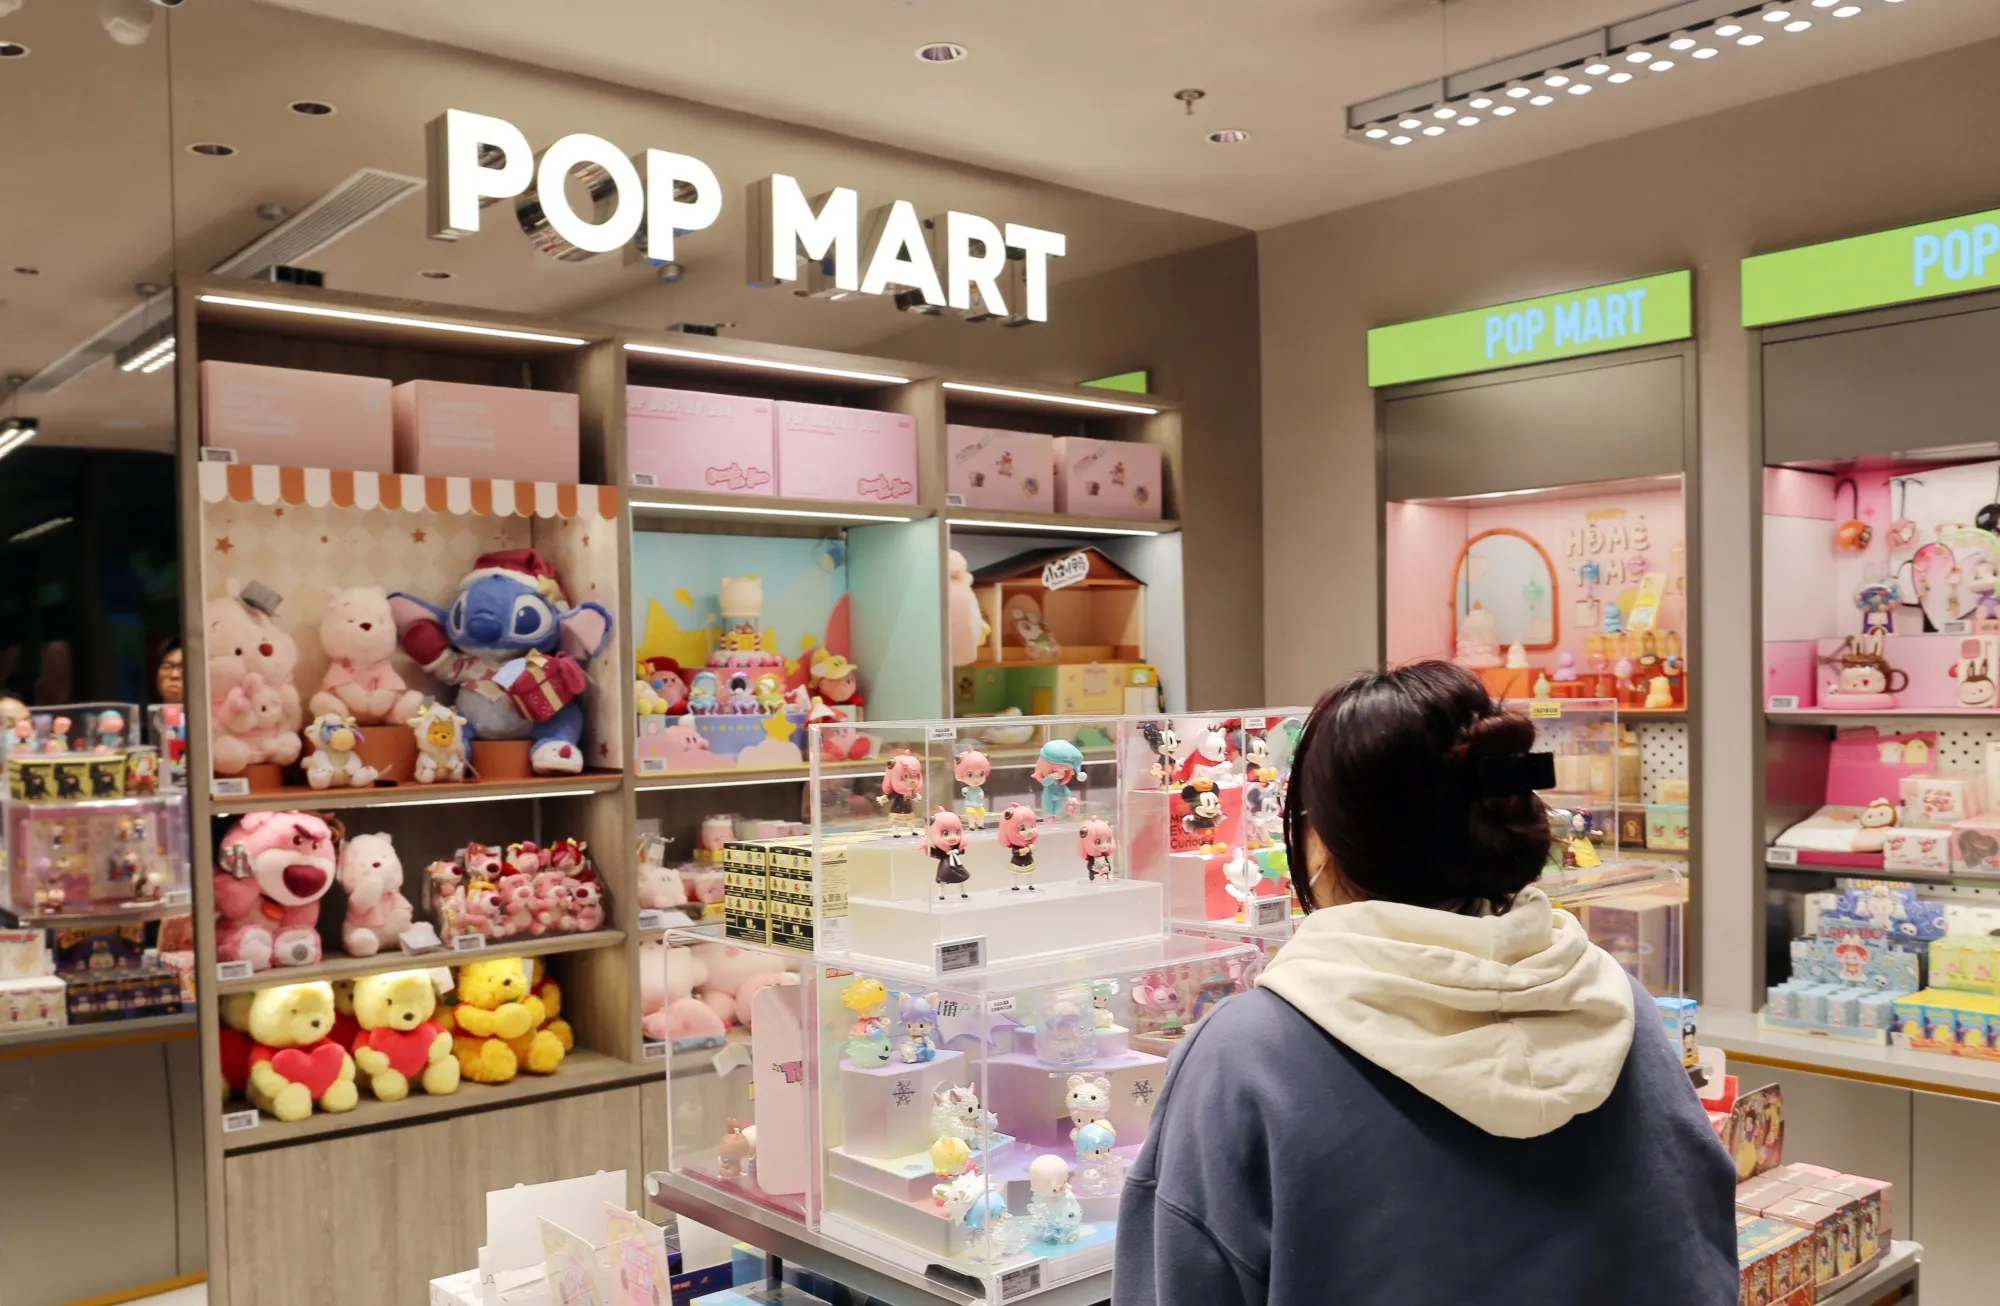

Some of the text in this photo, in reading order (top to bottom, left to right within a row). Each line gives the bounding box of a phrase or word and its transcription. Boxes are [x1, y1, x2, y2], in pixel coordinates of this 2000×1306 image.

[446, 108, 1067, 323] POP MART
[1912, 222, 2000, 288] POP
[1485, 287, 1647, 360] POP MART
